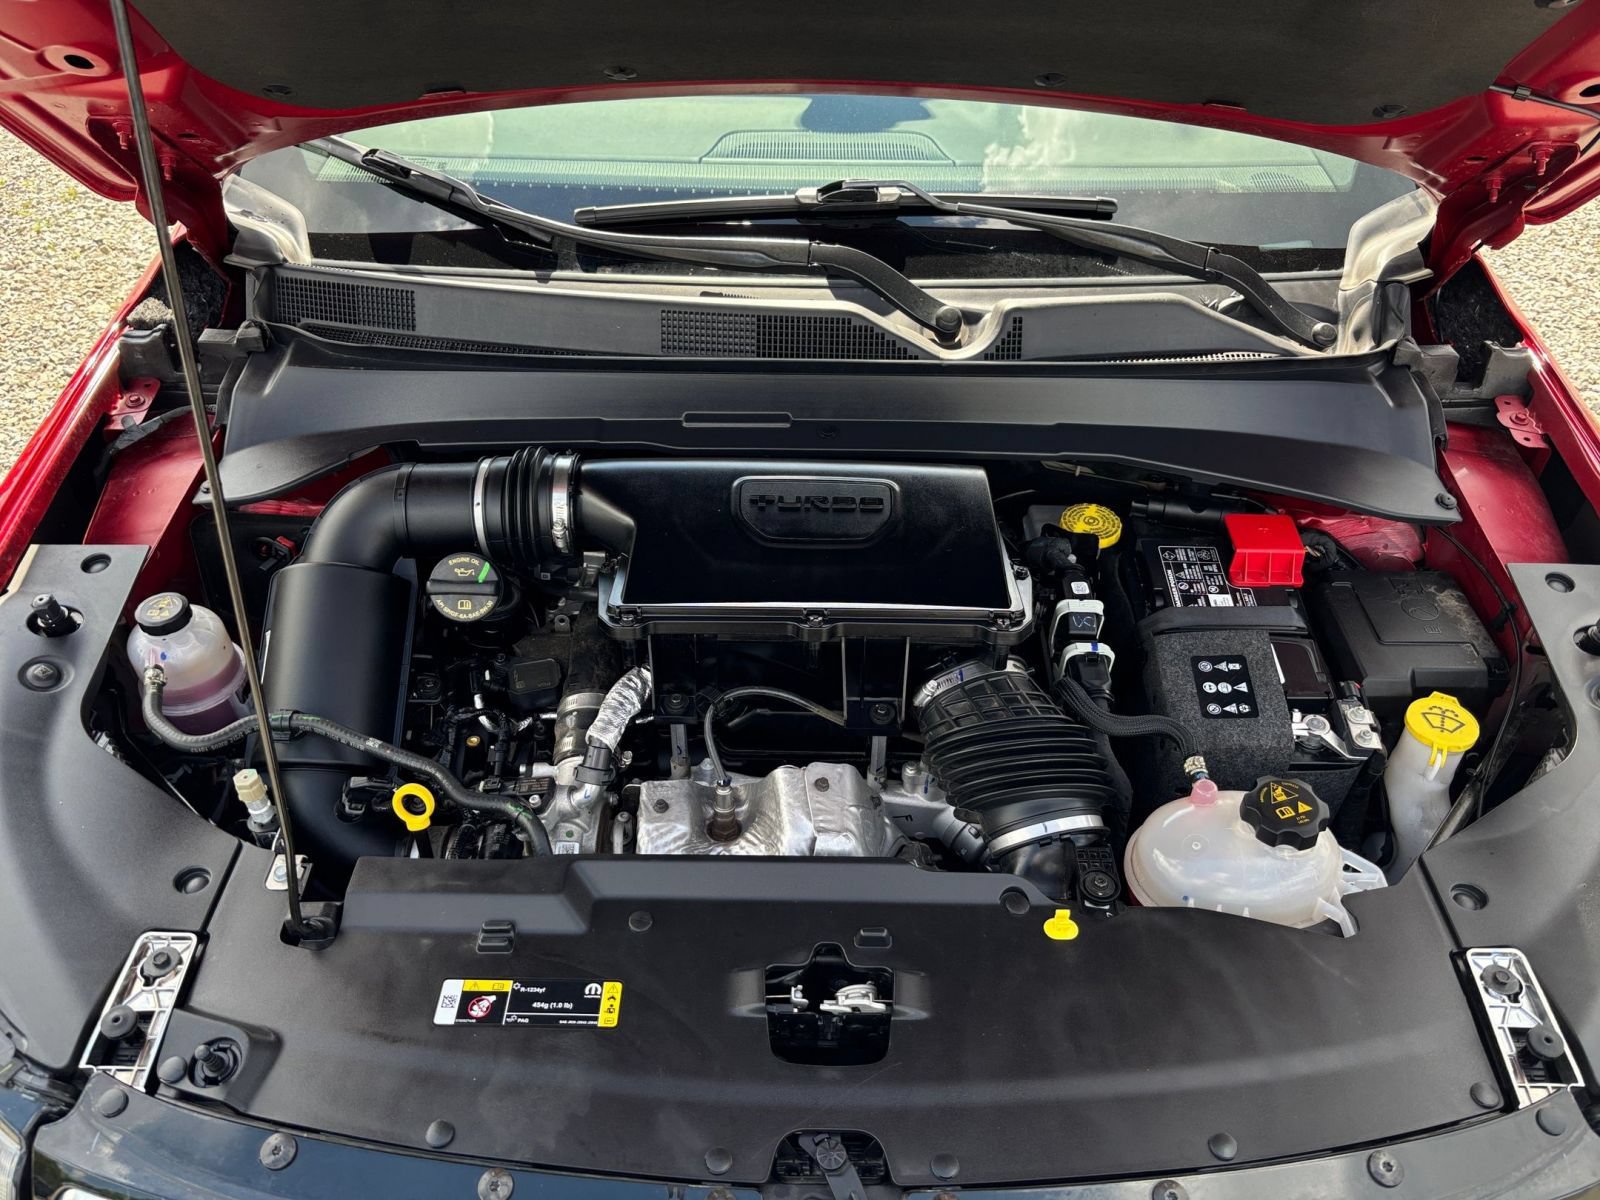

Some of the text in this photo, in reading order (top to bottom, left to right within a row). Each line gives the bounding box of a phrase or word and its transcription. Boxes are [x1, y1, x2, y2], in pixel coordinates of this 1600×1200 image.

[749, 494, 885, 512] TURBO
[448, 556, 480, 566] ENGINE OIL
[520, 986, 546, 994] R-1234yf
[532, 1001, 549, 1010] 454g
